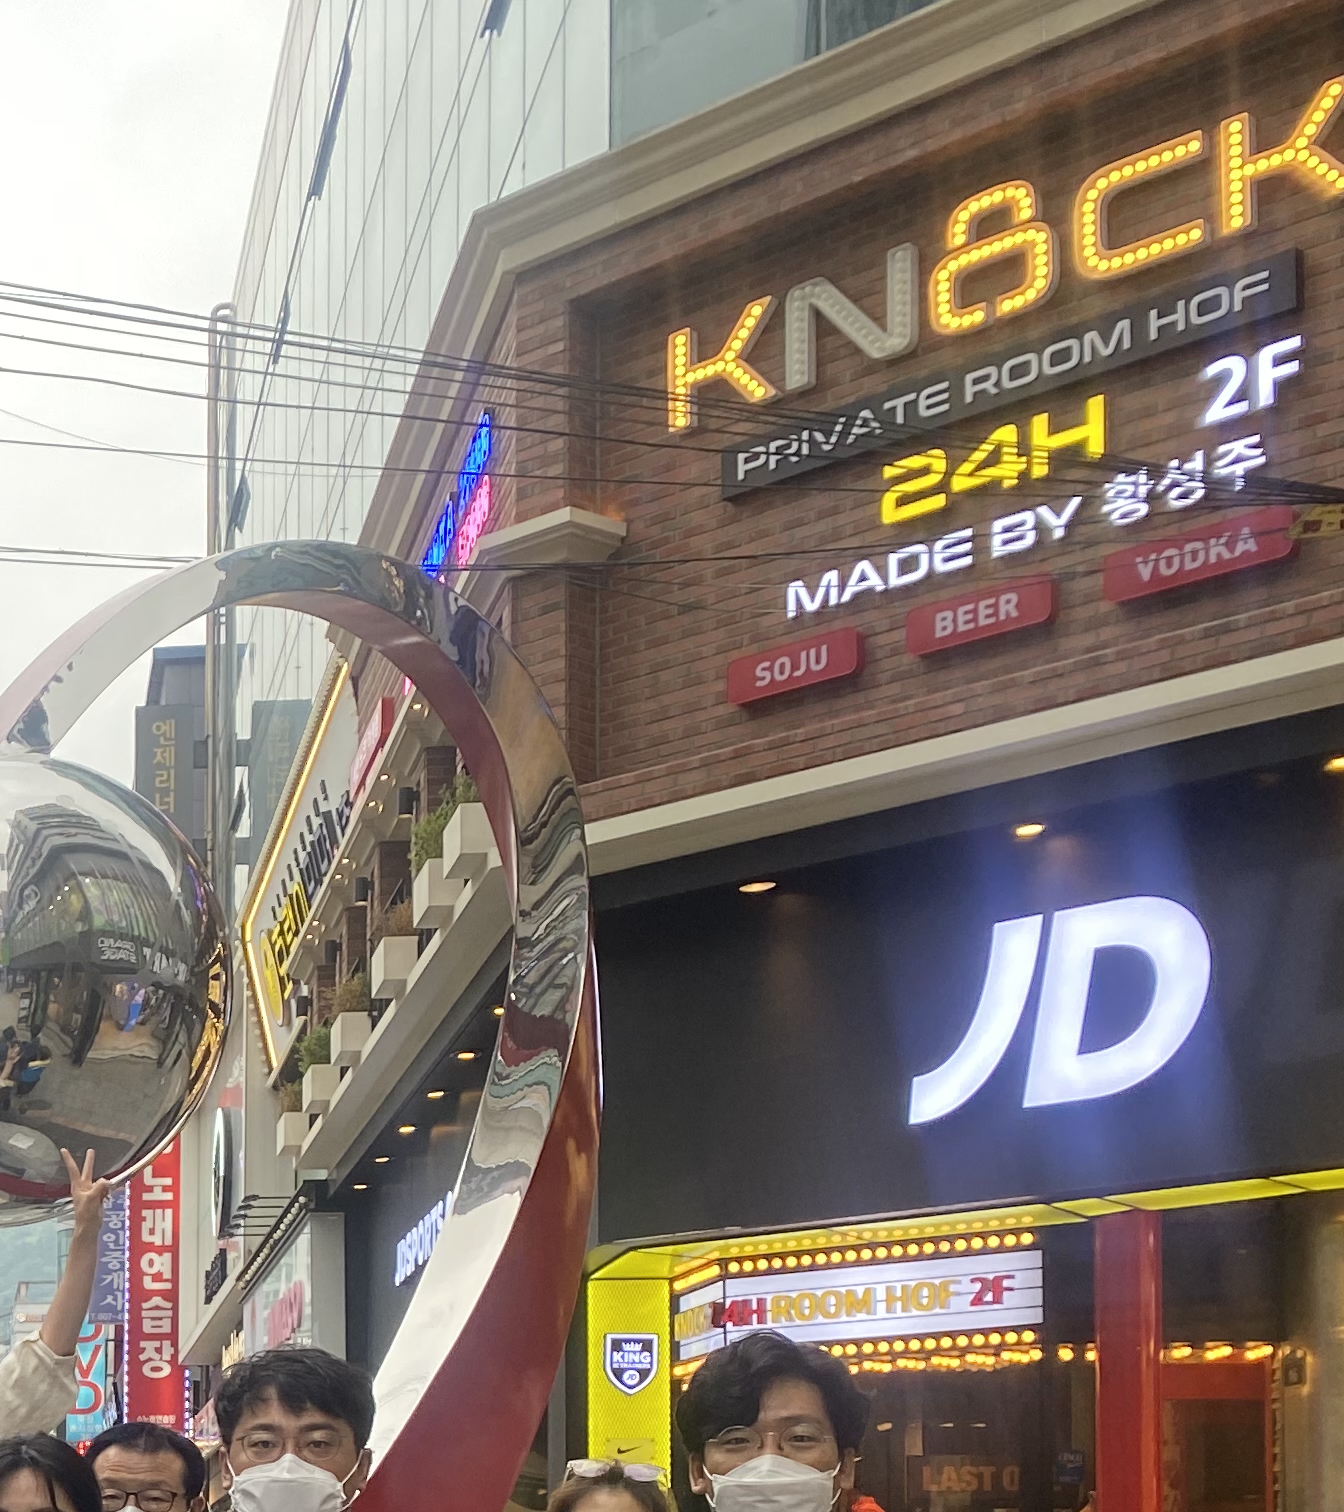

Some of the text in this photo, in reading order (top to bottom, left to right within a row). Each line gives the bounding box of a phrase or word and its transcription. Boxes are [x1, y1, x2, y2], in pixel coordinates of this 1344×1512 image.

[736, 269, 1271, 481] PRIVATE ROOM HOF
[1199, 335, 1303, 428] 2F
[881, 394, 1107, 525] 24H
[786, 526, 976, 619] MADE
[990, 495, 1083, 560] BY
[1135, 525, 1259, 581] VODKA
[934, 591, 1020, 639] BEER
[754, 645, 829, 687] SOJU
[908, 895, 1211, 1126] JD
[137, 1146, 175, 1380] 노래연습장
[771, 1286, 876, 1325] ROOM
[885, 1278, 962, 1314] HOF
[970, 1274, 1016, 1308] 2F
[612, 1351, 652, 1364] KING
[922, 1465, 996, 1492] LAST
